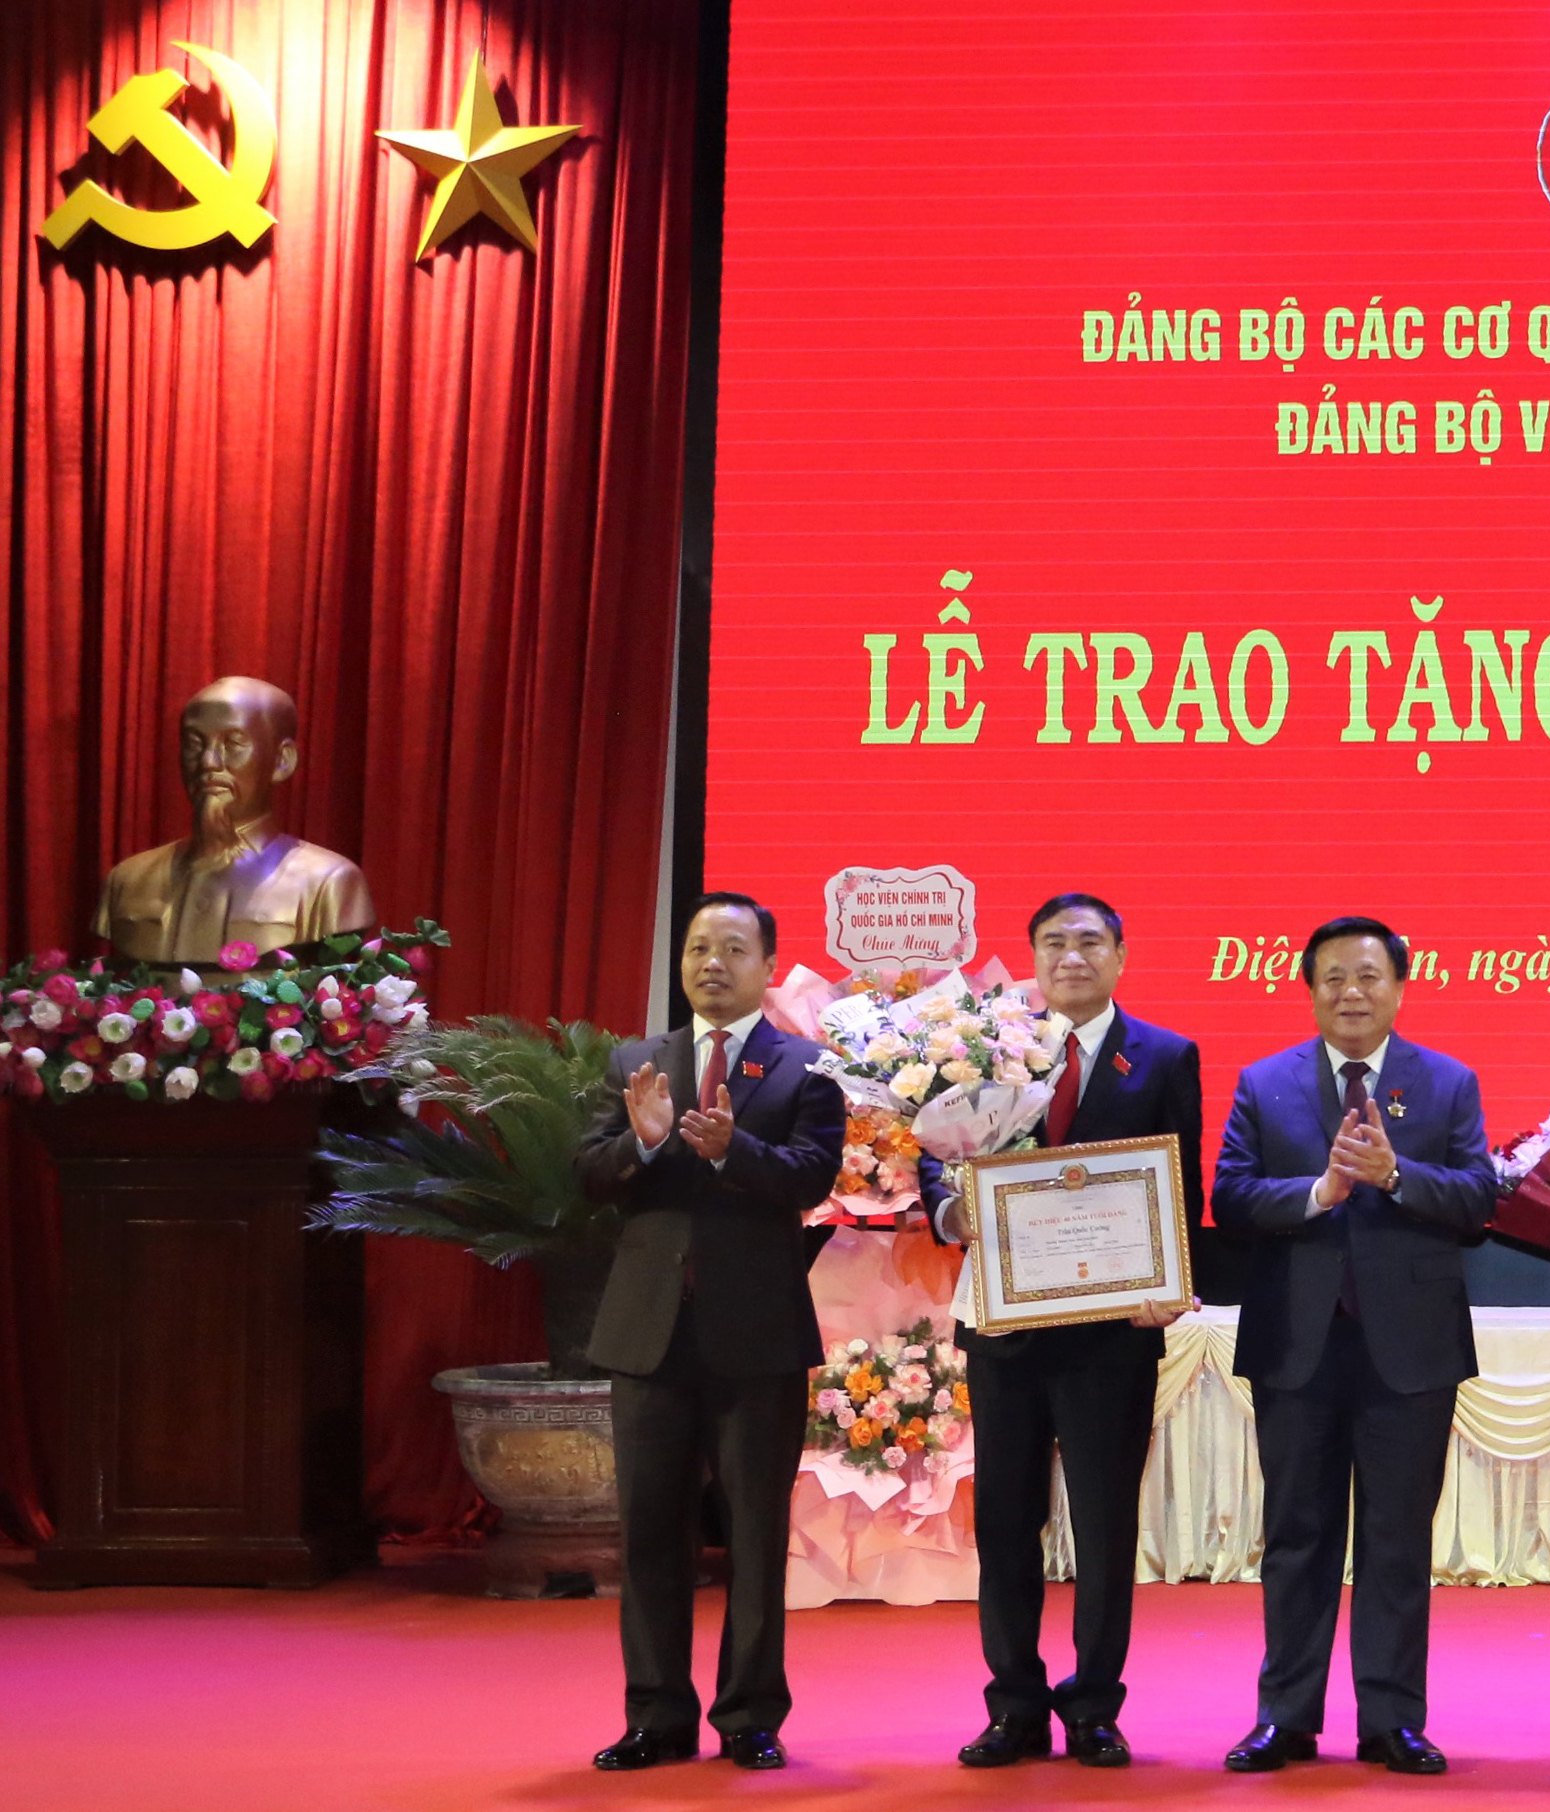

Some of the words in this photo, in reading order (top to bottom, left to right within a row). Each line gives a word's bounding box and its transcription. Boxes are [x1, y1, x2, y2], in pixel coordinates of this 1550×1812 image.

[1081, 292, 1221, 362] ĐẢNG
[1239, 297, 1305, 372] BỘ
[1324, 296, 1424, 360] CÁC
[1443, 301, 1511, 360] CƠ
[1275, 384, 1416, 454] ĐẢNG
[1435, 389, 1502, 465] BỘ
[861, 570, 985, 744] LỄ
[1023, 629, 1289, 745] TRAO
[851, 910, 876, 929] QUỐC
[878, 914, 894, 927] GIA
[911, 911, 926, 927] CHÍ
[929, 913, 954, 926] MINH
[857, 892, 876, 908] HỌC
[878, 889, 899, 908] VIỆN
[901, 889, 930, 905] CHÍNH
[932, 891, 946, 907] TRỊ
[862, 934, 896, 951] Chúc
